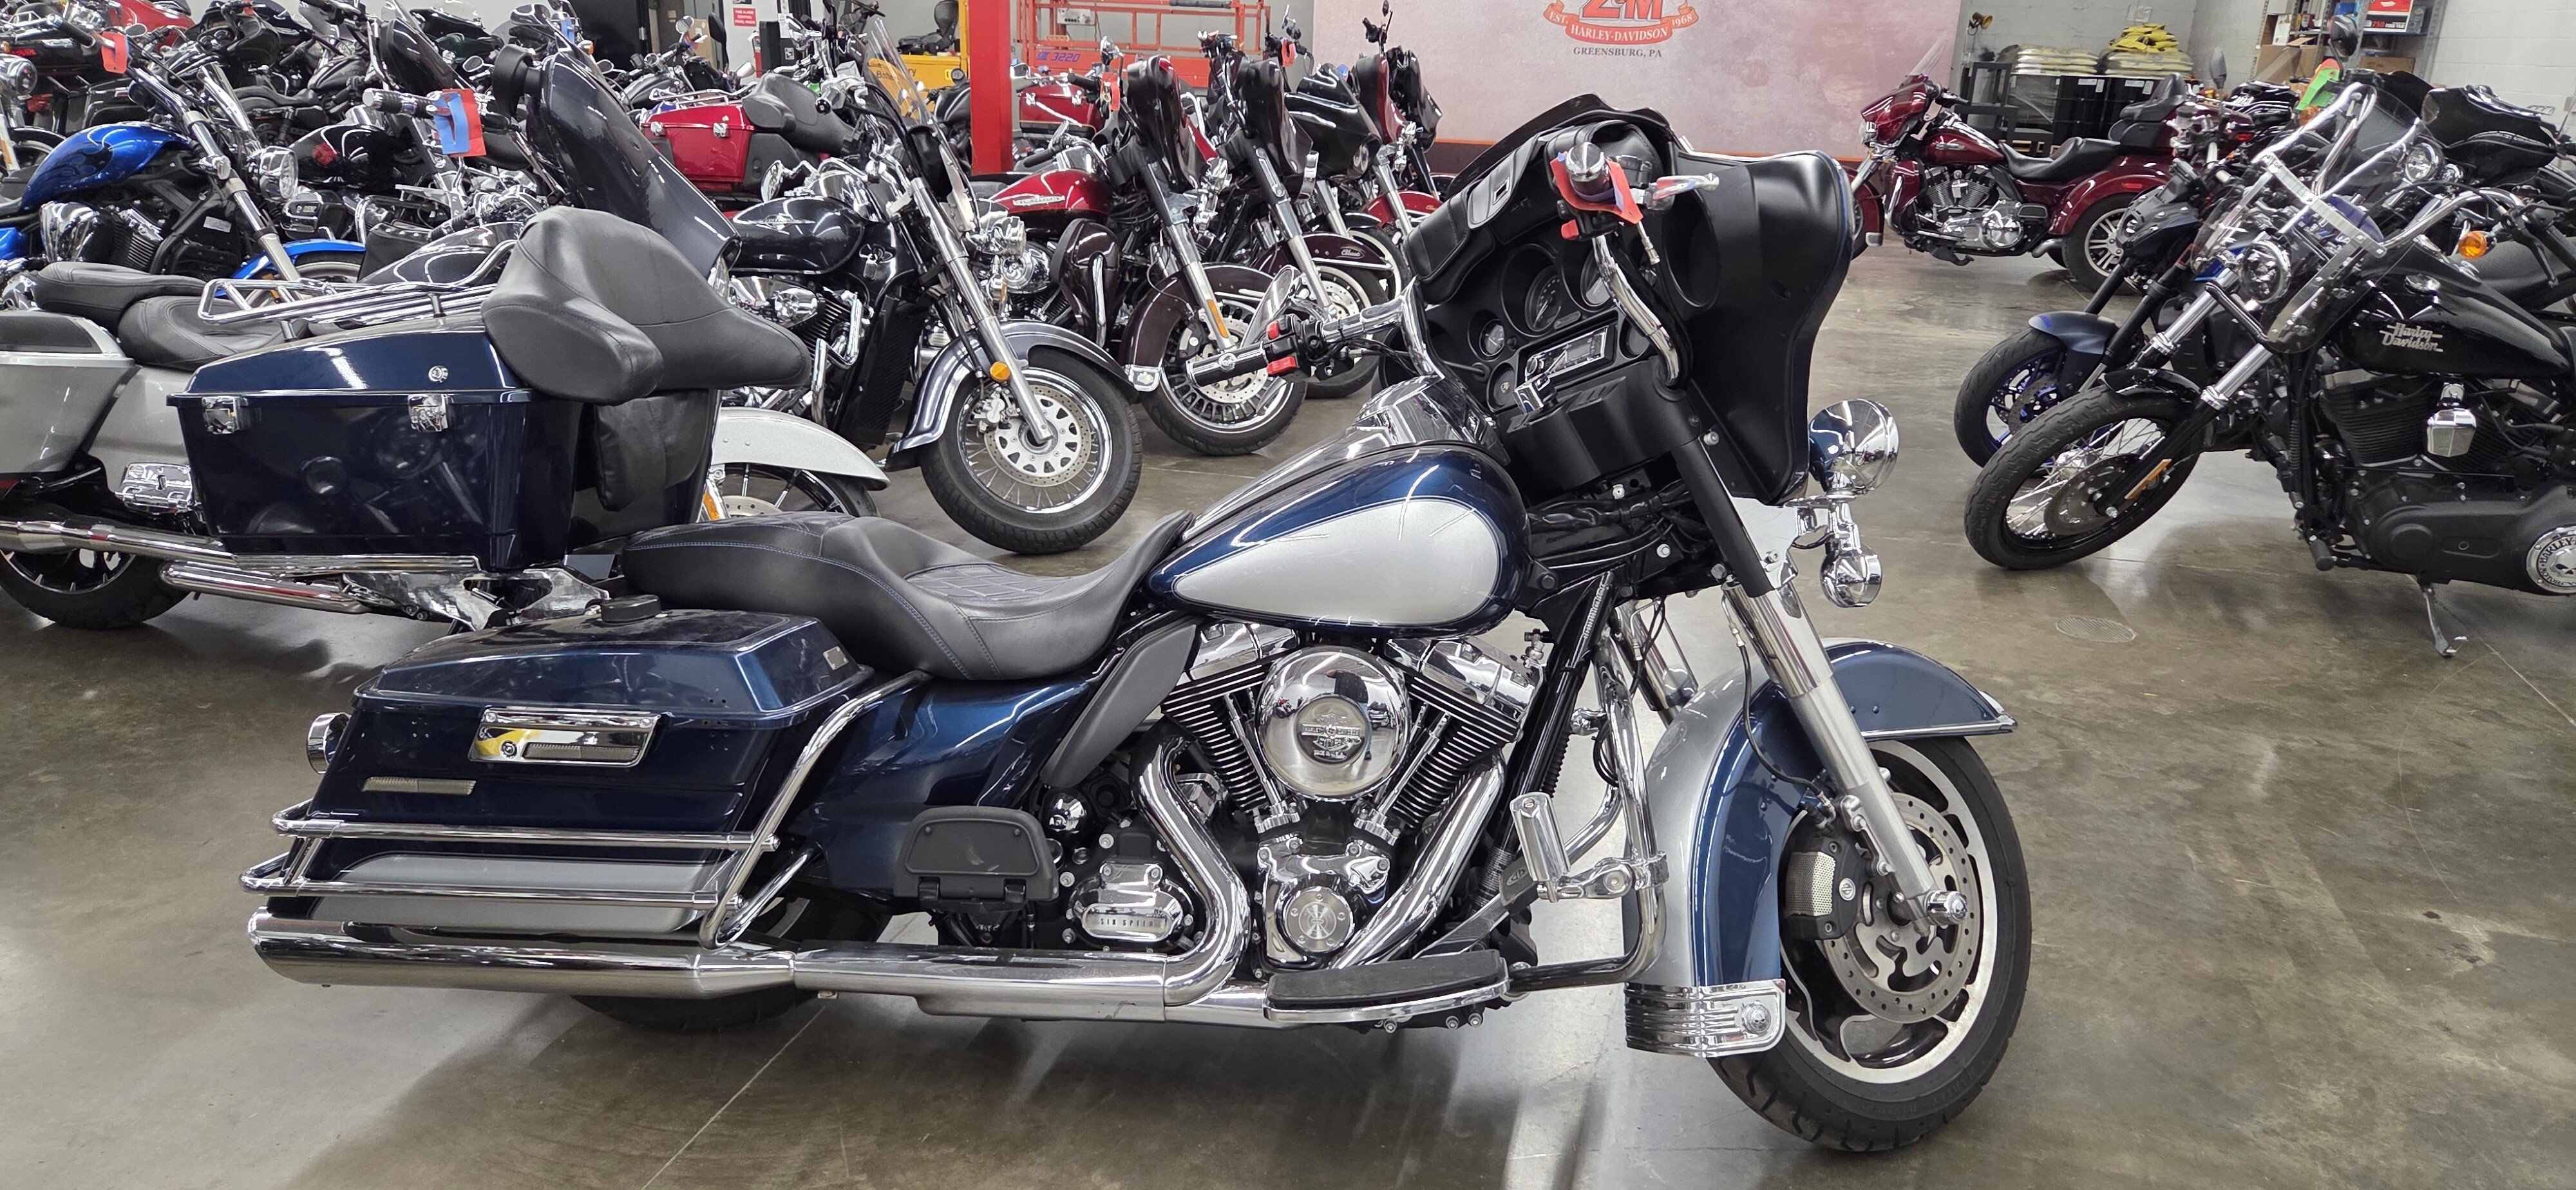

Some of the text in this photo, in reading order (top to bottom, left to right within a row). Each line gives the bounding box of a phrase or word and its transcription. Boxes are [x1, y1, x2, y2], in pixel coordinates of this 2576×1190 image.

[1549, 11, 1569, 24] EST.
[1672, 13, 1693, 27] 1968
[1571, 24, 1669, 42] HARLEY-DAVIDSON
[1051, 52, 1081, 62] 3220
[1573, 47, 1646, 58] GREENSBURG,
[2387, 322, 2443, 342] Harley
[2379, 330, 2443, 352] Davidson
